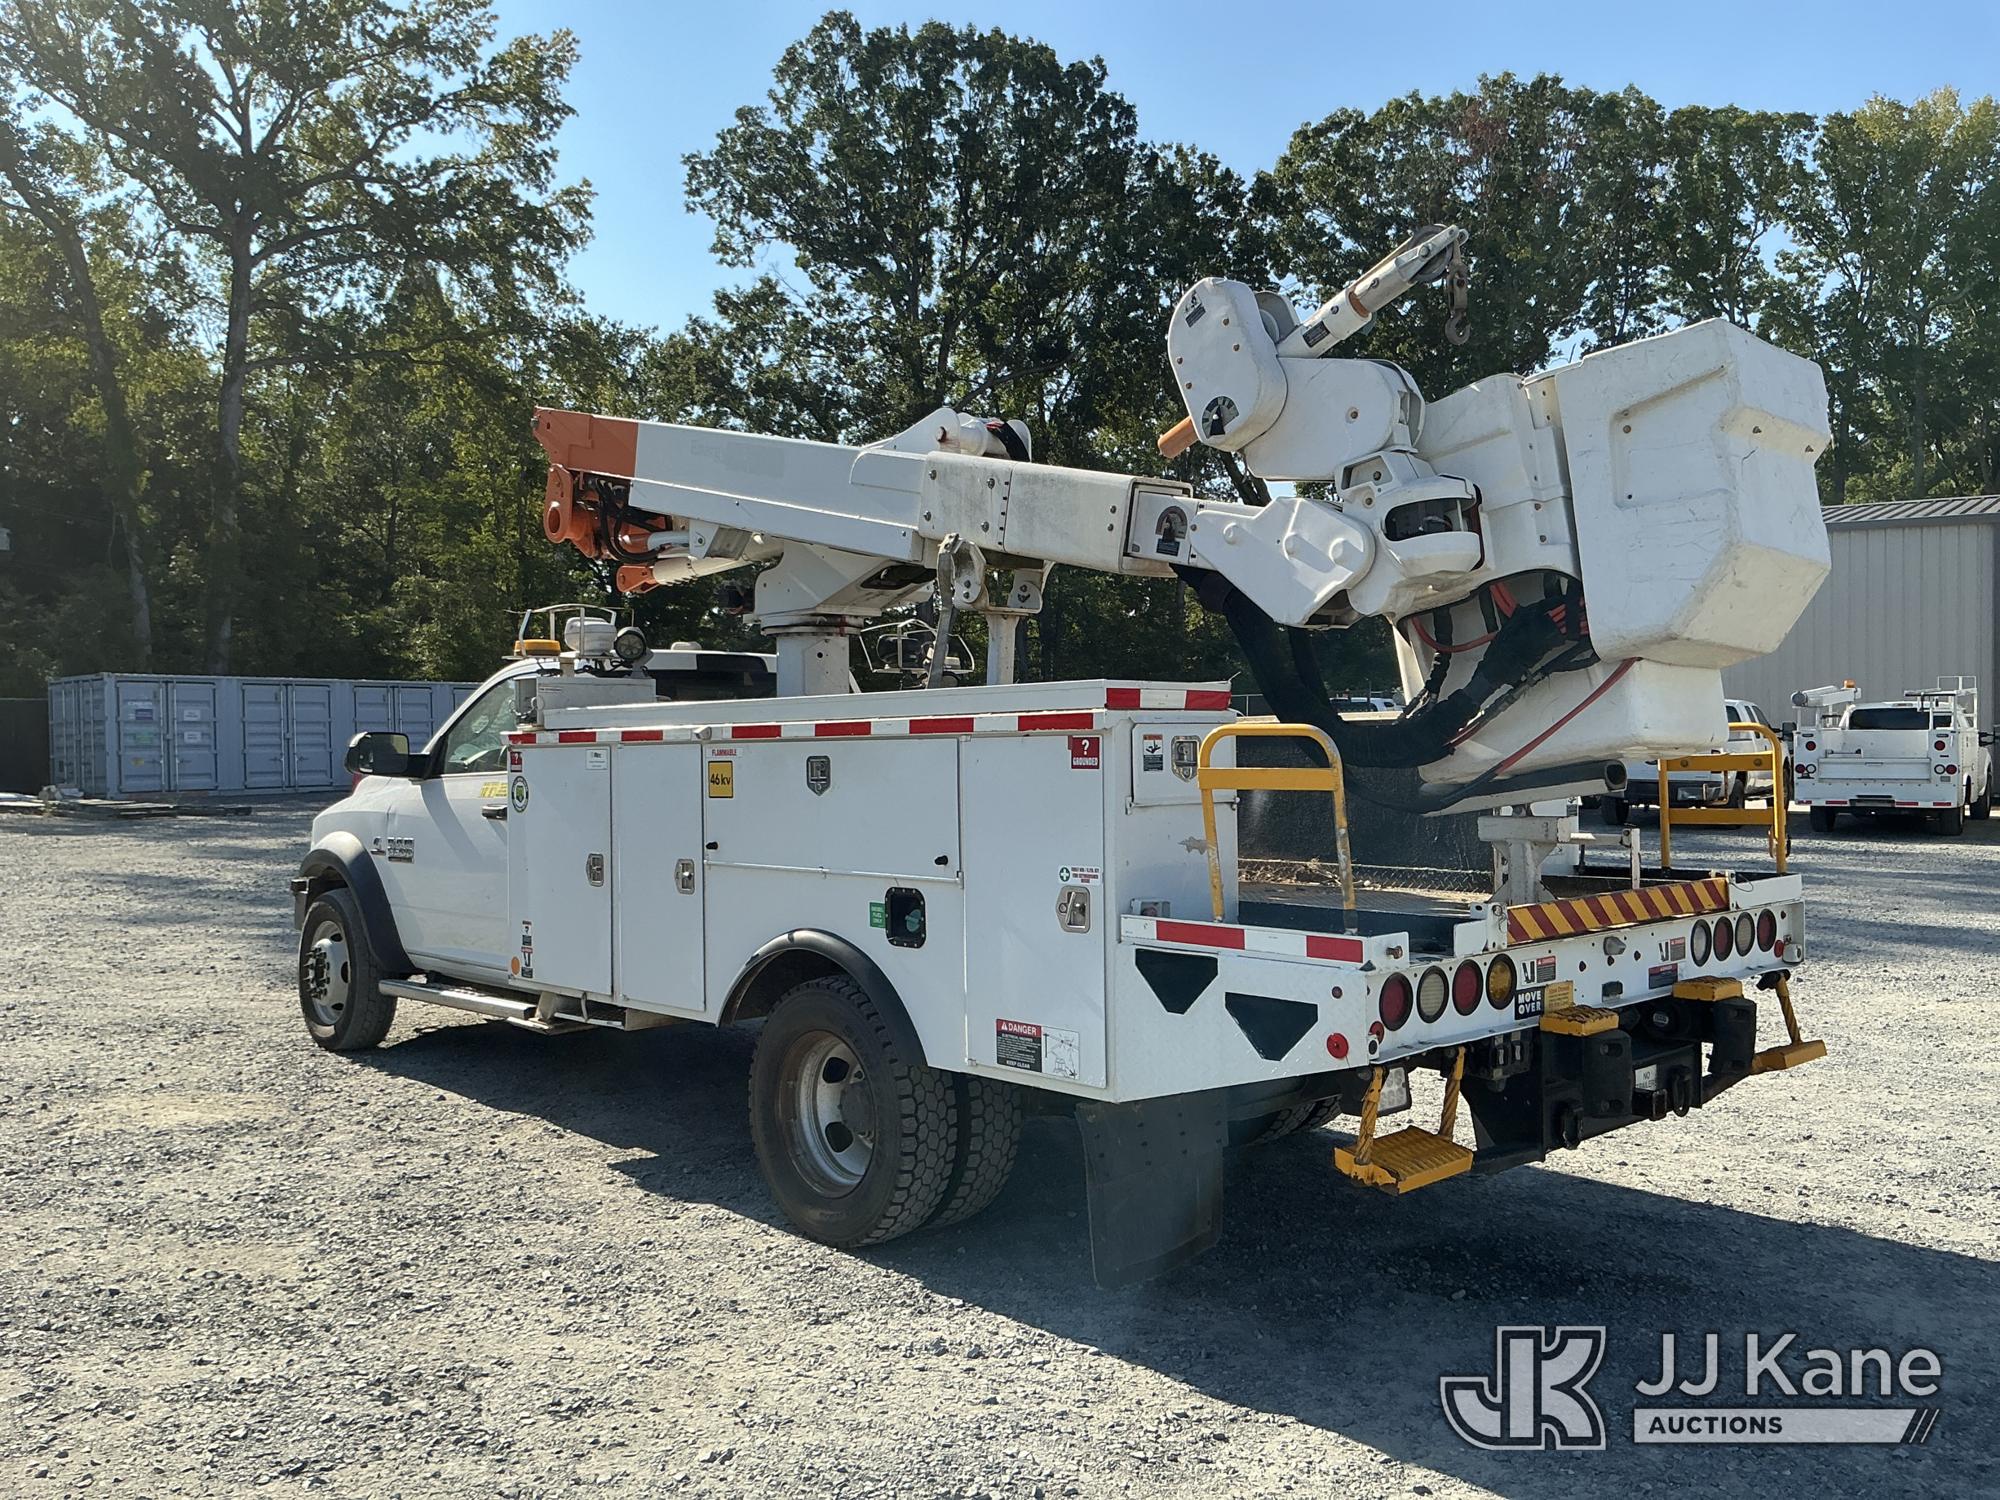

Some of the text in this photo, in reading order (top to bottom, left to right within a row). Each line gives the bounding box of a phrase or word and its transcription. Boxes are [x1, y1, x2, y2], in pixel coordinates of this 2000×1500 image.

[711, 748, 737, 757] FLAMMABLE
[1072, 757, 1098, 766] GROUNDED
[1518, 990, 1542, 1004] MOVE
[1518, 1001, 1542, 1015] OVER
[1008, 1022, 1037, 1036] DANGER
[1643, 1071, 1650, 1080] NO
